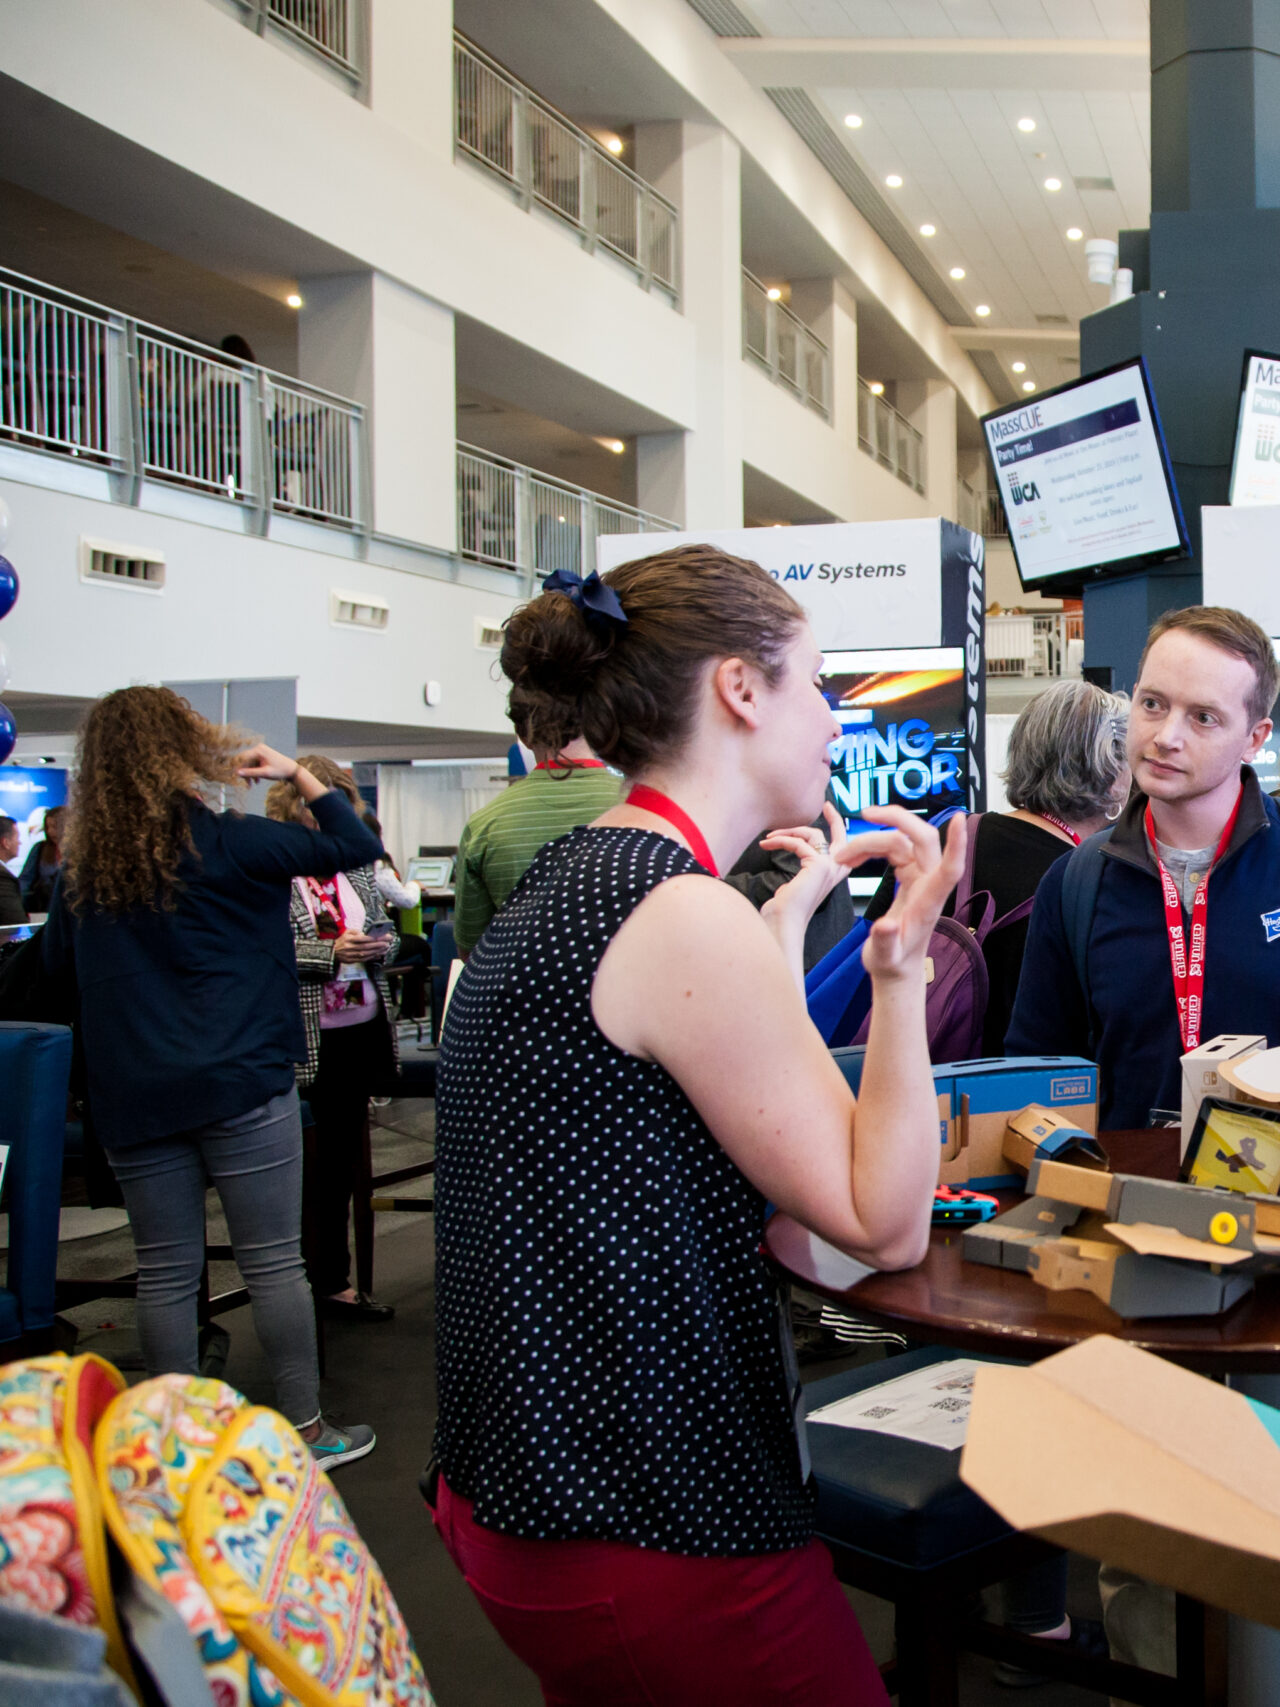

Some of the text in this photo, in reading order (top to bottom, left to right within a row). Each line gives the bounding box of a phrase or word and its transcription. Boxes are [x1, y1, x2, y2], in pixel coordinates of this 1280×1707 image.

[990, 406, 1044, 443] MassCUE
[1010, 481, 1041, 506] WCA
[783, 563, 815, 581] AV
[818, 562, 907, 584] Systems
[1174, 938, 1187, 979] UNIFIED
[1191, 923, 1202, 963] UNIFIED
[1188, 994, 1198, 1034] UNIFIED
